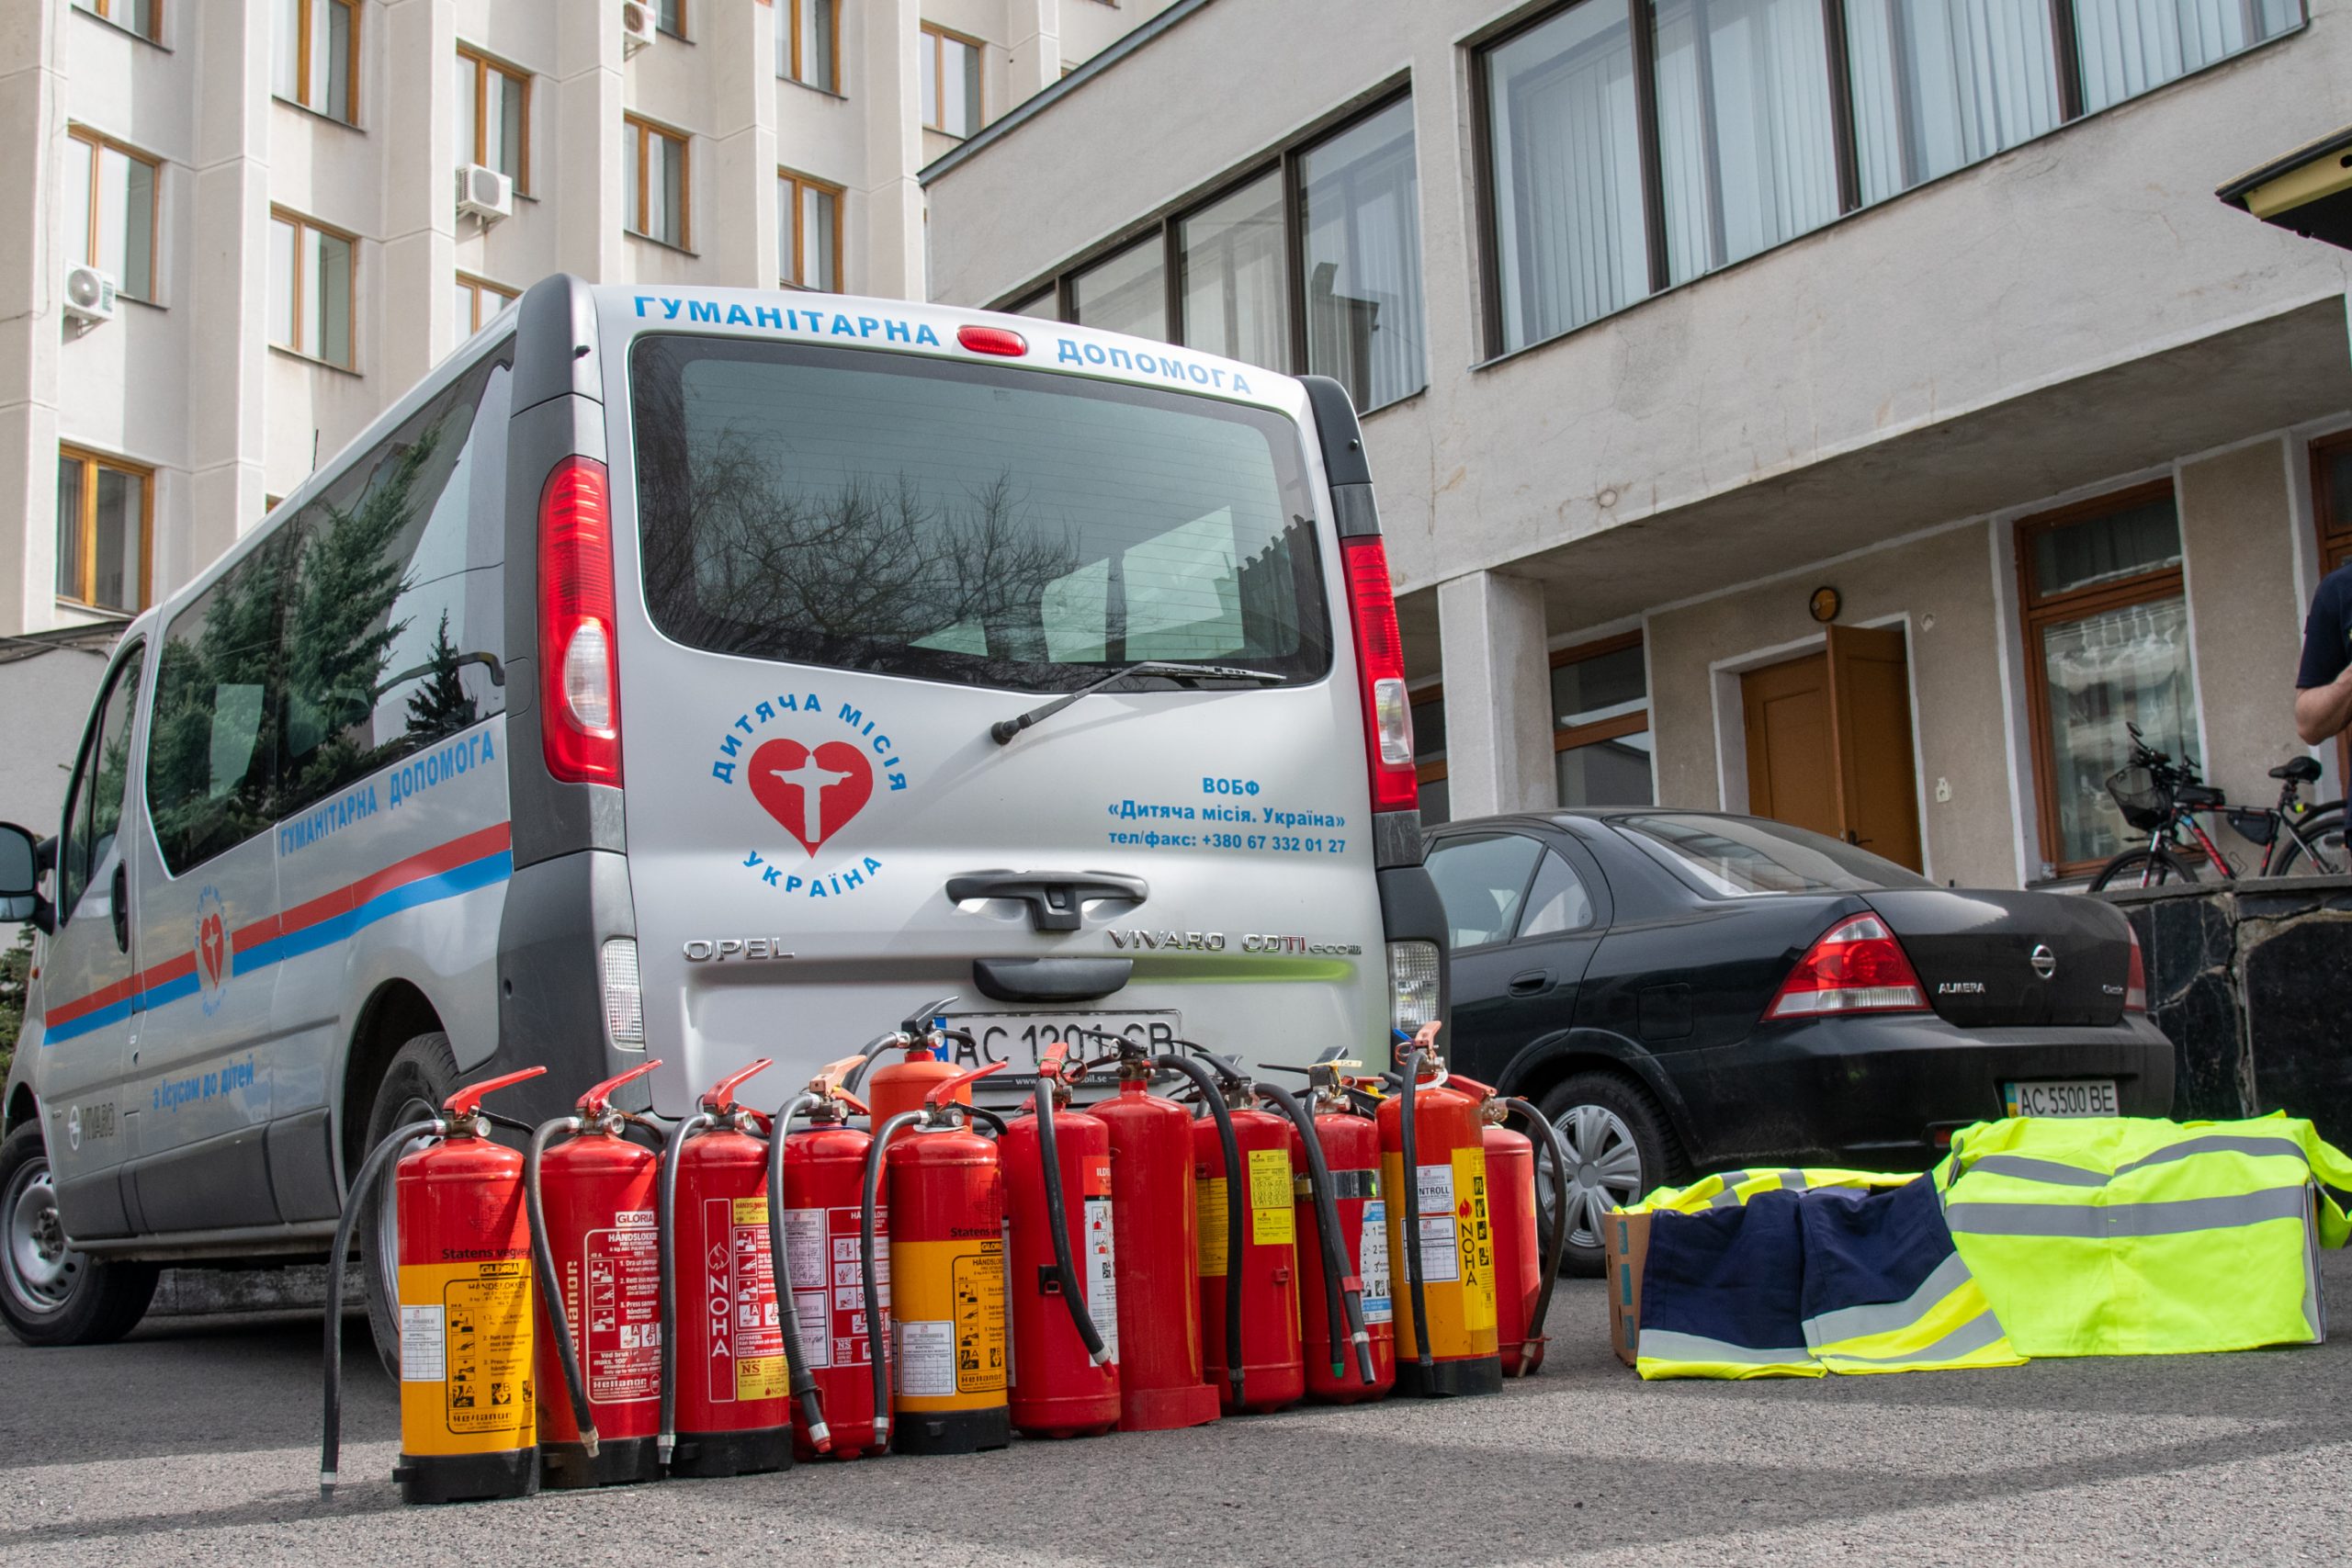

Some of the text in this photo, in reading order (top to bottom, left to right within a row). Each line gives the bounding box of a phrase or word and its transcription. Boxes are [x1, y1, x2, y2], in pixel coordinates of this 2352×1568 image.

[634, 296, 1252, 395] ГУМАНІТАРНА ДОПОМОГА
[712, 694, 908, 791] ДИТЯЧА МІСІЯ
[280, 730, 494, 857] ГУМАНІТАРНА ДОПОМОГА
[1202, 777, 1260, 796] ВОБФ
[1108, 800, 1345, 829] «Дитяча місія. Україна»
[1109, 830, 1346, 853] тел/факс: +380 67 332 01 27
[742, 851, 882, 897] УКРАЇНА
[683, 937, 795, 962] OPEL
[1107, 930, 1226, 951] VIVARO
[1242, 933, 1306, 953] CDTI
[1939, 983, 1985, 994] ALMERA
[956, 1026, 1009, 1069] AC
[203, 1071, 218, 1101] до
[220, 1054, 254, 1098] дітей
[2022, 1085, 2115, 1115] AC 5500 BE
[1419, 1185, 1451, 1196] NTROLL
[616, 1213, 653, 1224] GLORIA
[950, 1227, 990, 1237] Statens
[442, 1247, 493, 1259] Statens
[1373, 1245, 1378, 1255] 2
[1461, 1222, 1477, 1287] NOHA
[858, 1292, 865, 1303] 3
[709, 1275, 731, 1358] NOHA
[632, 1325, 639, 1334] A
[972, 1349, 979, 1358] A
[741, 1363, 761, 1374] NS
[466, 1384, 474, 1394] A
[503, 1382, 511, 1392] B
